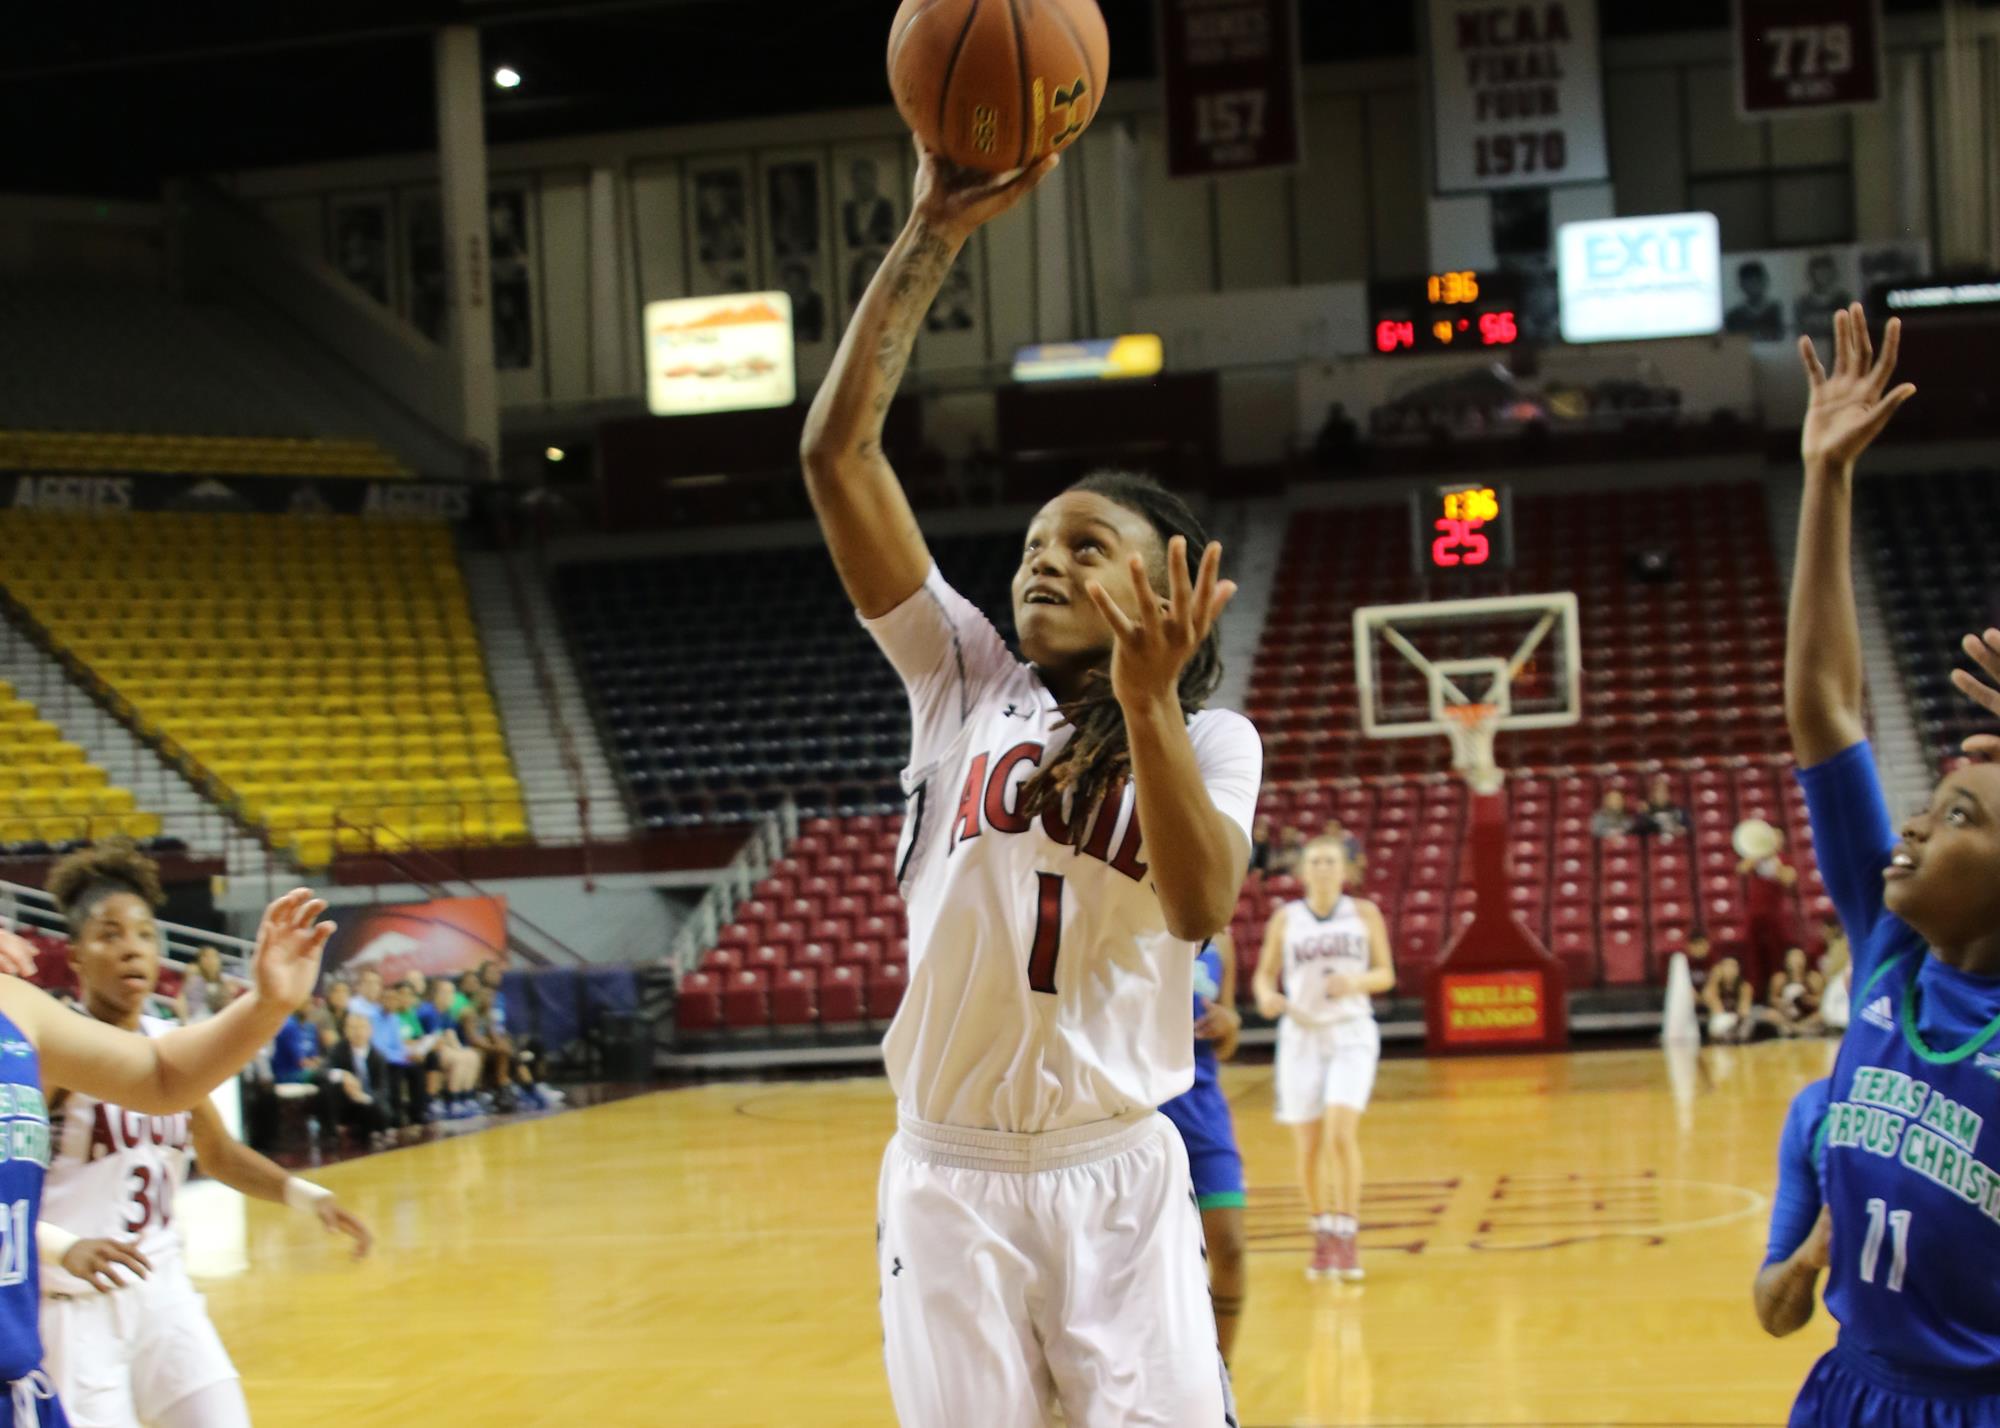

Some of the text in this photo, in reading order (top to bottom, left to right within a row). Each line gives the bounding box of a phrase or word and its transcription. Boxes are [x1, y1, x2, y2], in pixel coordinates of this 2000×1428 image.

[1457, 3, 1571, 49] NCAA
[1764, 23, 1852, 77] 779
[1467, 50, 1563, 85] FINAL
[1196, 89, 1265, 141] 157
[1475, 86, 1559, 122] FOUR
[1475, 130, 1565, 176] 1970
[1585, 228, 1702, 278] EXIT
[1376, 320, 1414, 352] 64
[14, 477, 134, 510] AGGIES
[361, 484, 469, 516] AGGIES
[1432, 518, 1489, 567] 25
[1028, 871, 1064, 994] 1
[1848, 1066, 1931, 1119] TEXAS
[1920, 1090, 1983, 1154] A&M
[1899, 1123, 2000, 1226] CHRIST
[1860, 1198, 1912, 1292] 11
